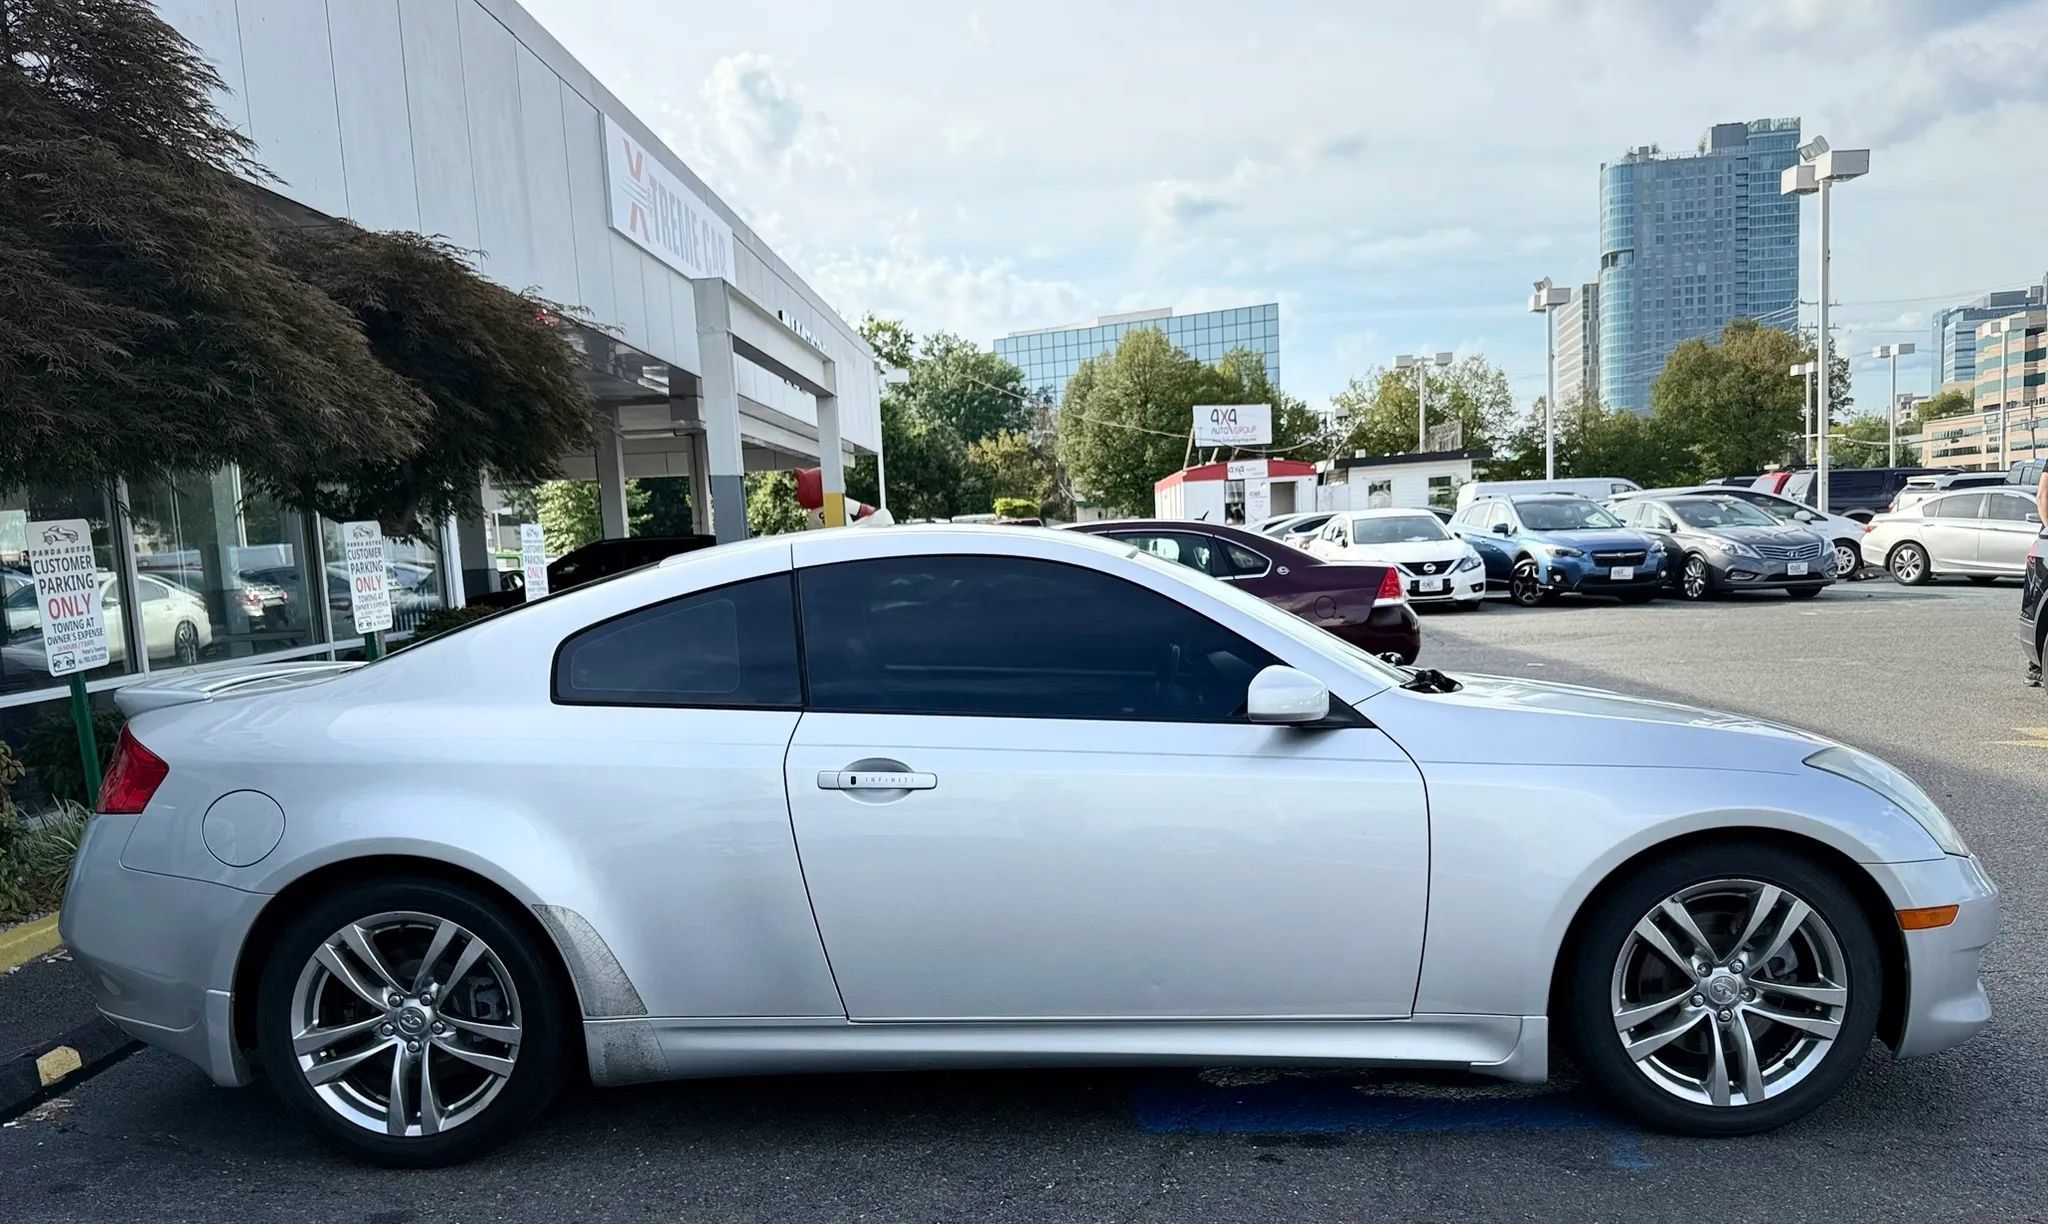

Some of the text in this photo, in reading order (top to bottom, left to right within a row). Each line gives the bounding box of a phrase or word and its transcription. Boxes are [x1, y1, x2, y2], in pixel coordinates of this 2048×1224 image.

[1211, 425, 1257, 435] AUTO GROUP
[32, 544, 91, 557] PANDA AUTOS
[348, 547, 382, 560] CUSTOMER
[33, 555, 94, 575] CUSTOMER
[350, 560, 384, 575] PARKING
[527, 565, 544, 579] ONLY
[39, 573, 94, 595] PARKING
[356, 575, 381, 593] ONLY
[48, 593, 91, 620] ONLY
[52, 617, 95, 634] TOWING AT
[47, 627, 104, 646] OWNER'S EXPENSE
